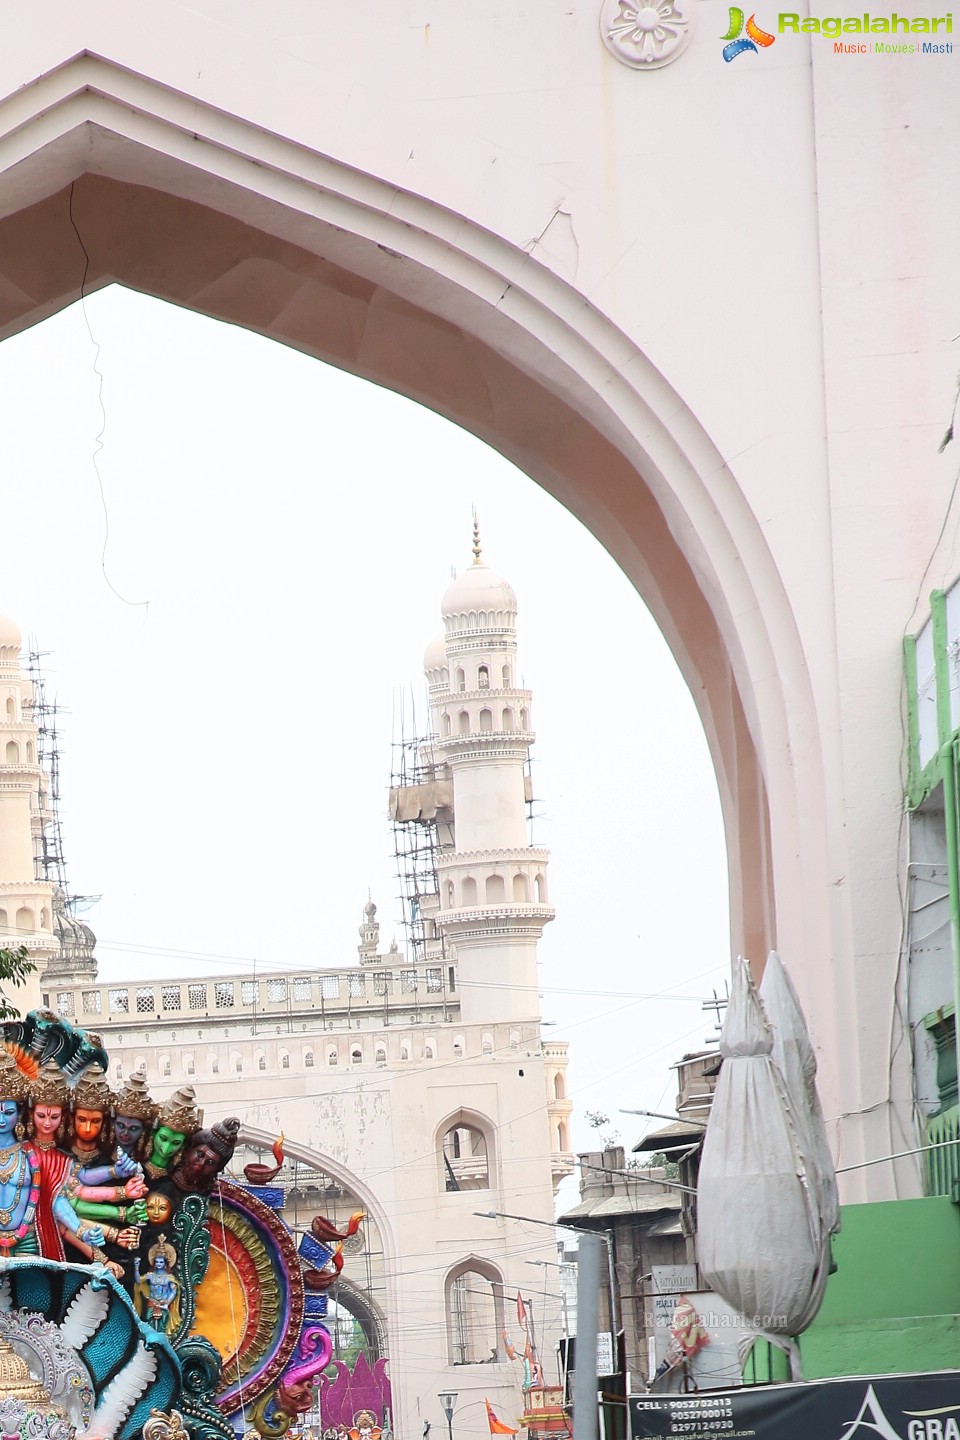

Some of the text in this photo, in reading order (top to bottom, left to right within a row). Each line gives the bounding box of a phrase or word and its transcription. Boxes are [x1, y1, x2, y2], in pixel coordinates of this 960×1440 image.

[636, 1401, 662, 1411] CELL
[669, 1398, 732, 1409] 9052702413
[670, 1408, 733, 1420] 9052700015
[671, 1420, 734, 1432] 8297124930
